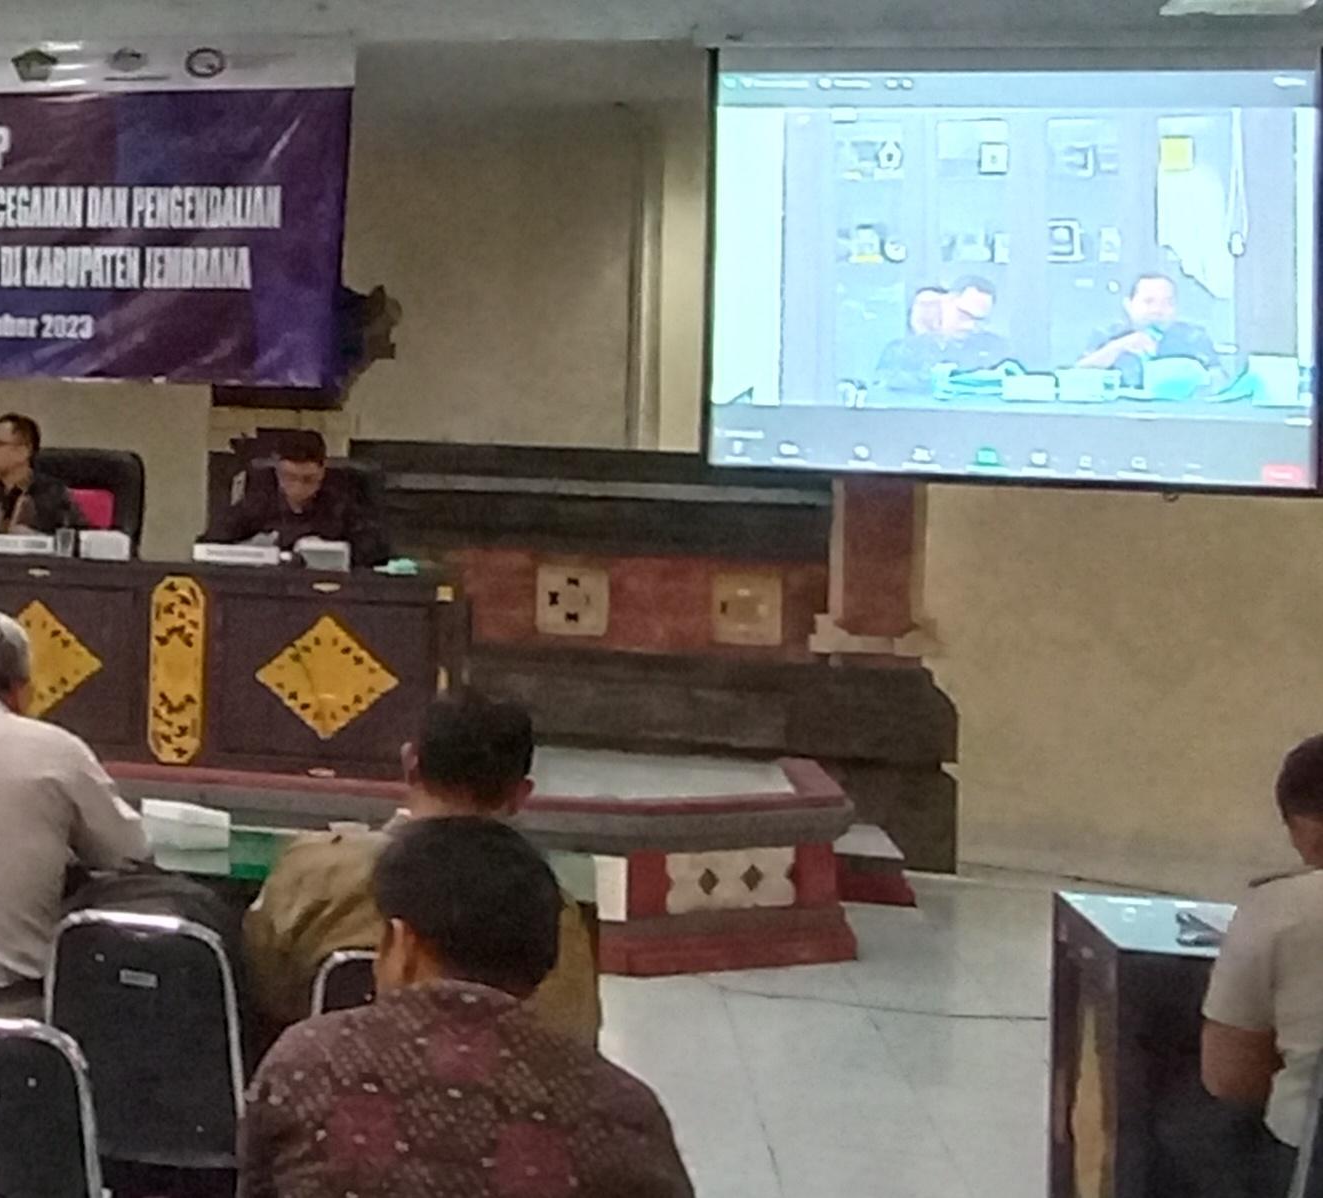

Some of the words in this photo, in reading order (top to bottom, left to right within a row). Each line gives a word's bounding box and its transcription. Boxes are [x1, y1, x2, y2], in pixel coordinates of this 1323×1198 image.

[86, 186, 130, 228] DAN
[132, 186, 282, 228] PENGENDALIAN
[0, 247, 22, 288] DI
[24, 247, 141, 289] KABUPATEN
[143, 247, 252, 289] JEMBRANA
[41, 314, 95, 340] 2023
